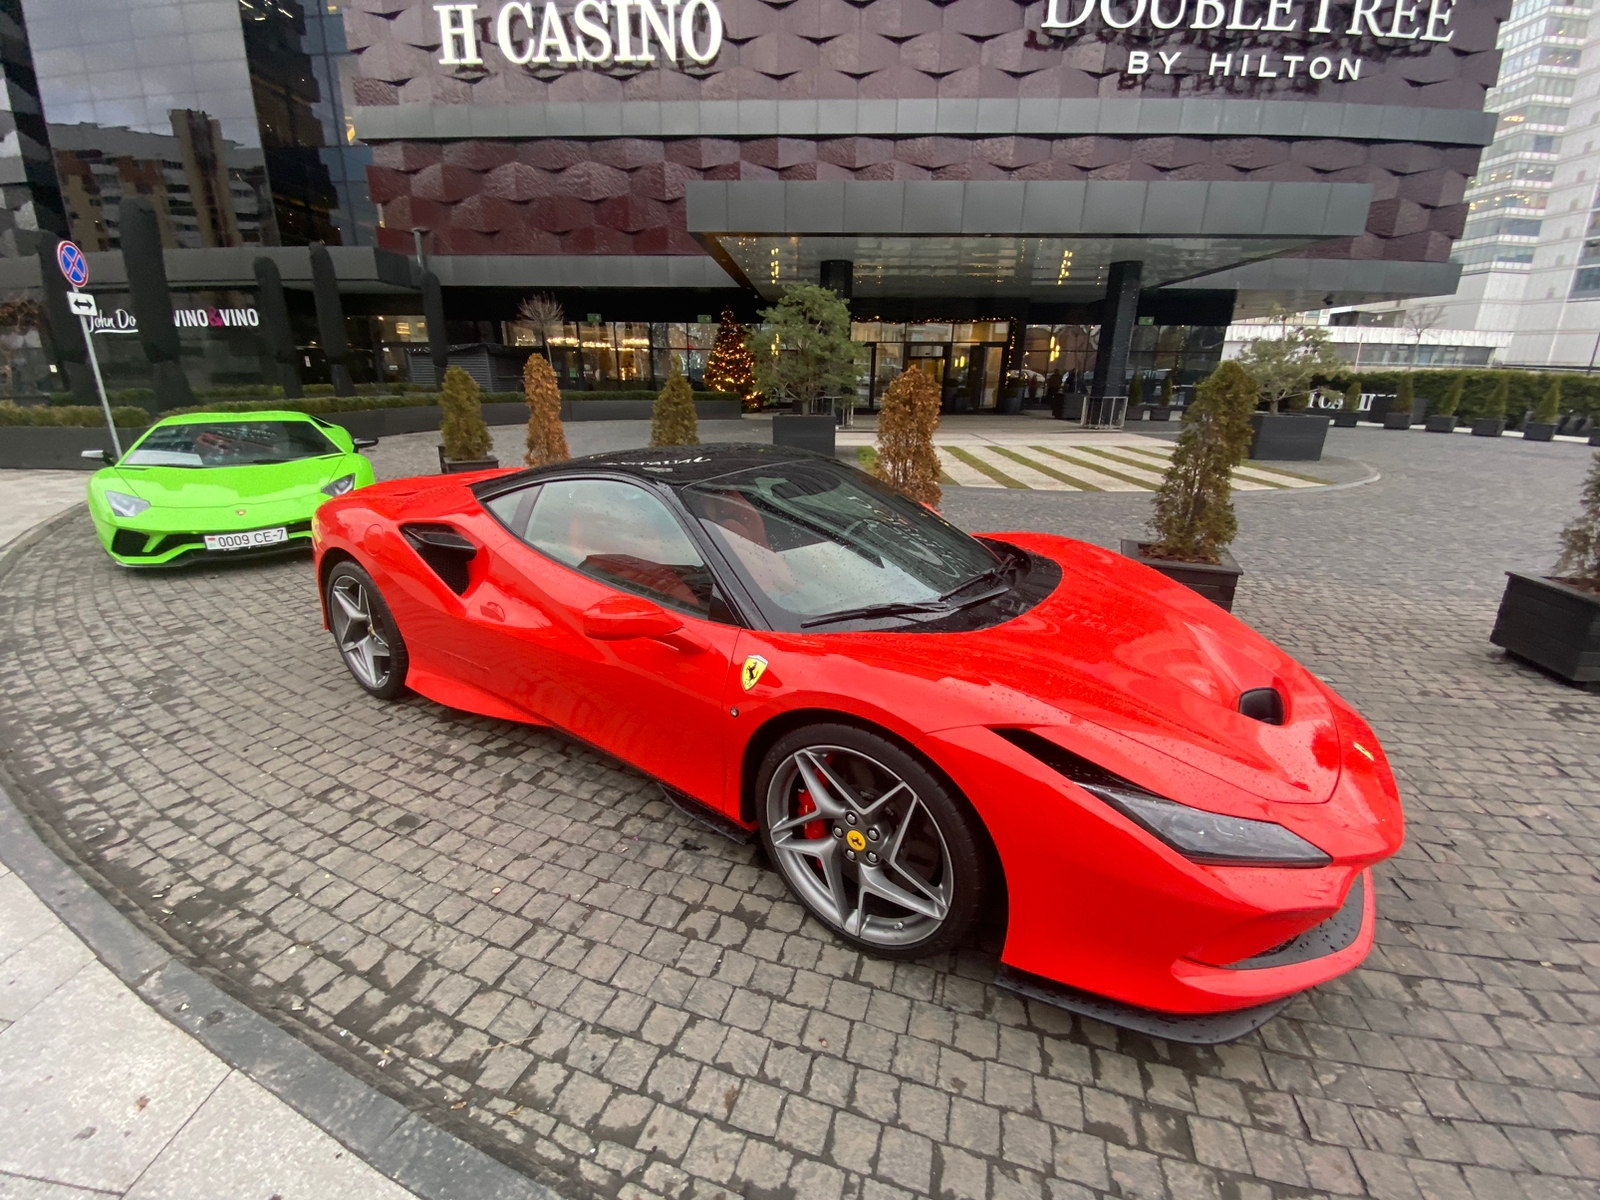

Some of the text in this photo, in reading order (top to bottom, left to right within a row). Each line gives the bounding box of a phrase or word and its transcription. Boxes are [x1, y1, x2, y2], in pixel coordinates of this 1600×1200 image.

[433, 0, 723, 65] H CASINO
[1127, 51, 1362, 81] BY HILTON
[218, 535, 250, 547] 0009
[253, 529, 285, 544] CE-7
